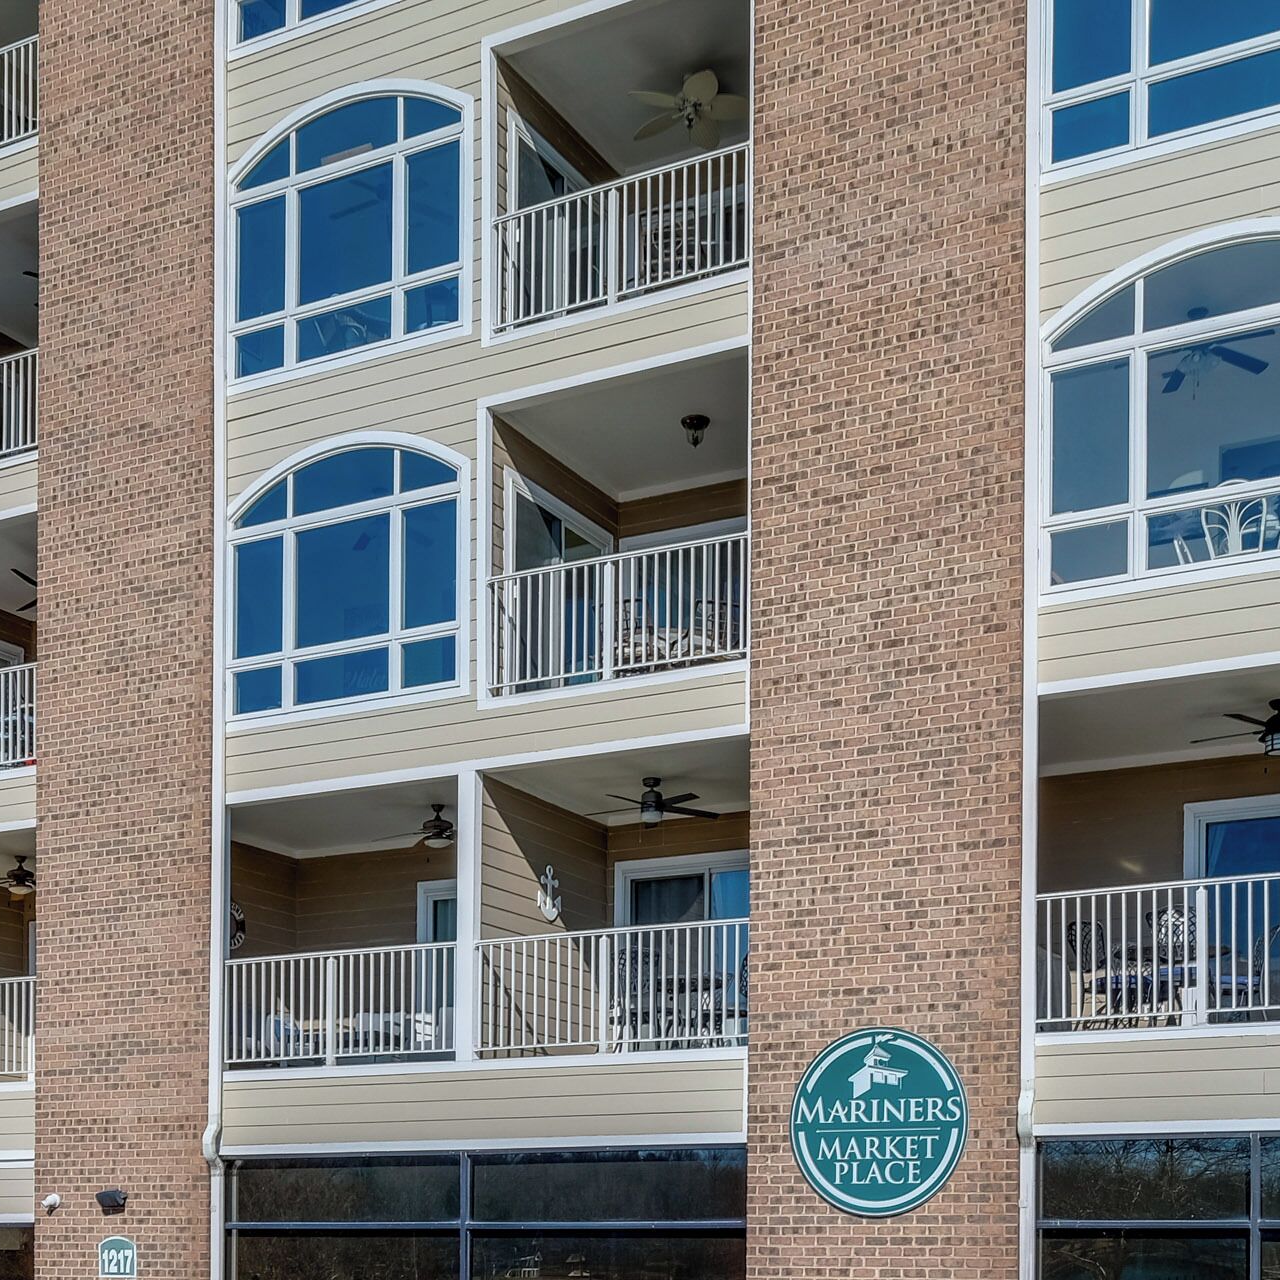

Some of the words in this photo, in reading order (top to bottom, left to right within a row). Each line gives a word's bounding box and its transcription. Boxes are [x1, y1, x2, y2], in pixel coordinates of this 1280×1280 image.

[795, 1096, 961, 1124] MARINERS
[816, 1135, 939, 1160] MARKET
[833, 1160, 922, 1185] PLACE
[102, 1248, 133, 1274] 1217
